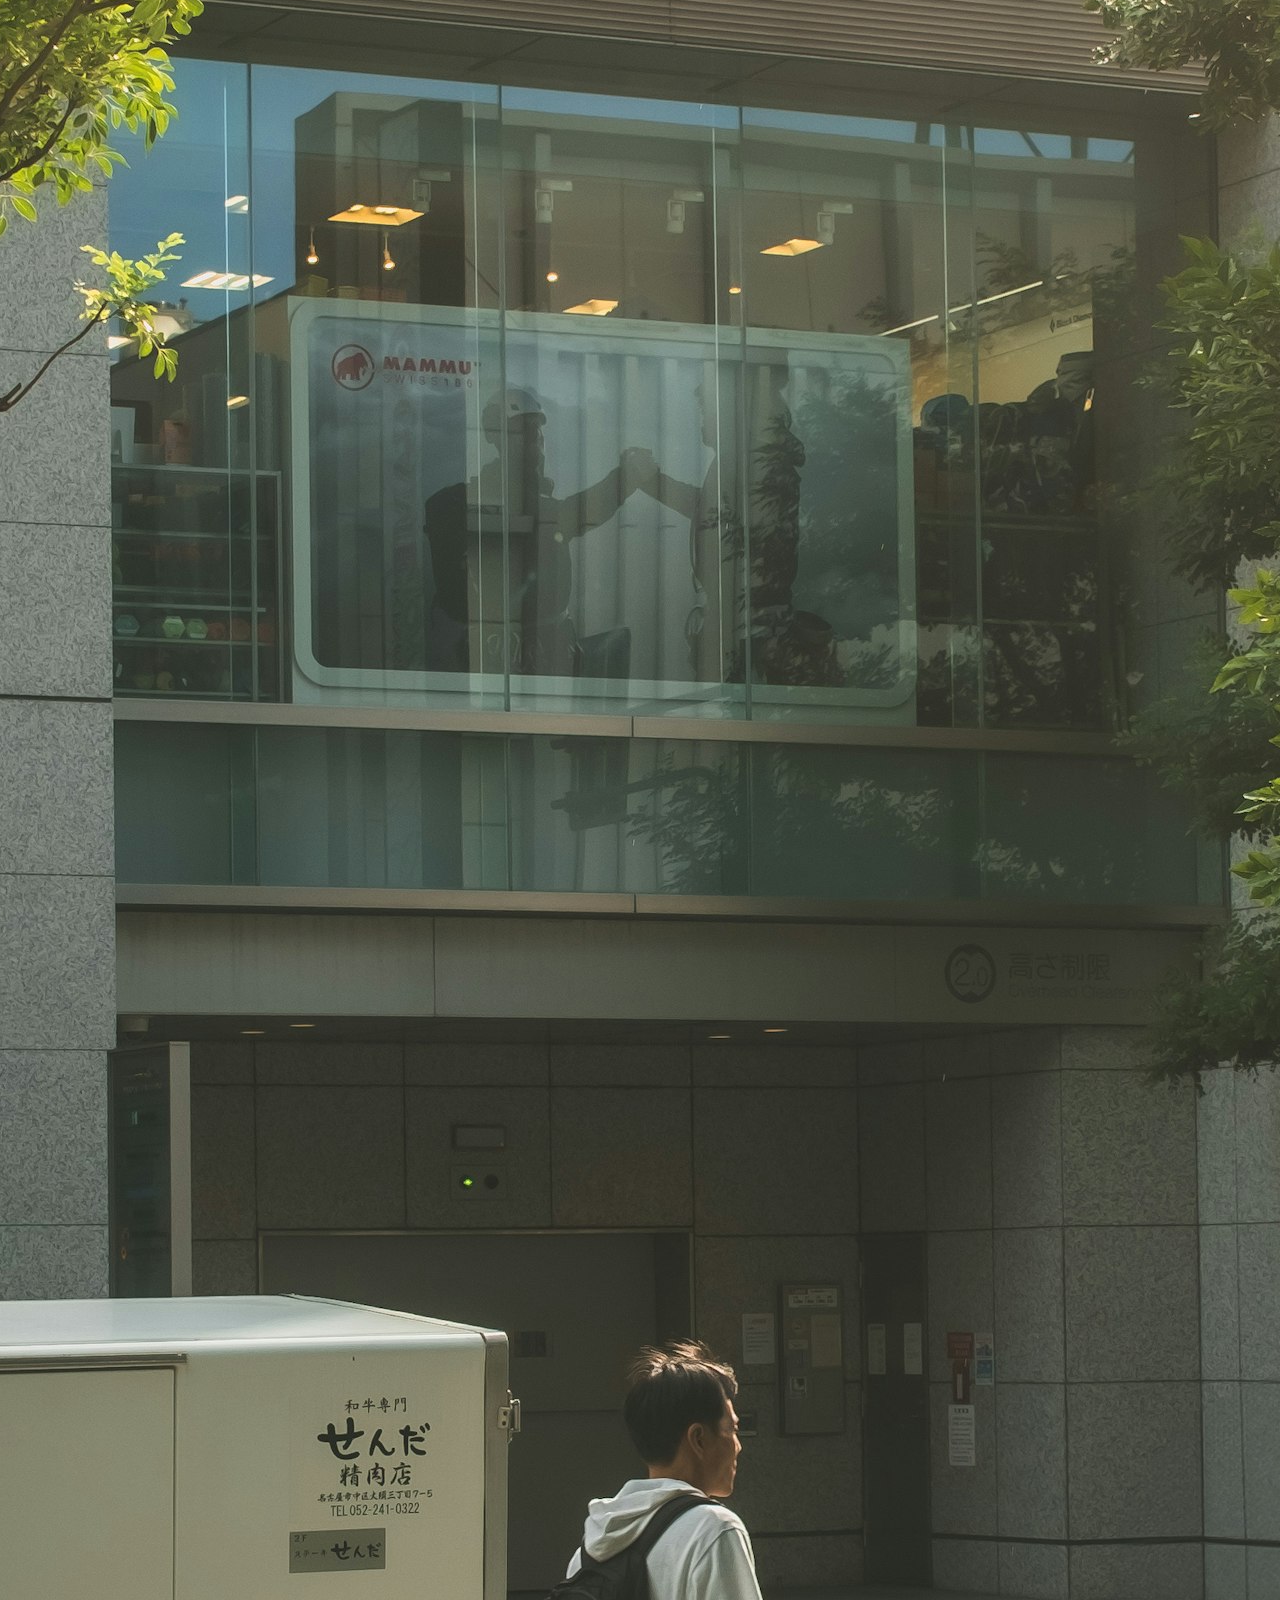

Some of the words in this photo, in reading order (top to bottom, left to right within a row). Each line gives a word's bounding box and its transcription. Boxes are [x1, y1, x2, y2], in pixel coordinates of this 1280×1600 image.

[383, 356, 482, 376] MAMMU
[1008, 952, 1112, 982] 高さ制限
[344, 1397, 407, 1414] 和牛専門
[317, 1417, 430, 1460] せんだ
[340, 1462, 413, 1487] 精肉店
[330, 1540, 382, 1561] せんだ
